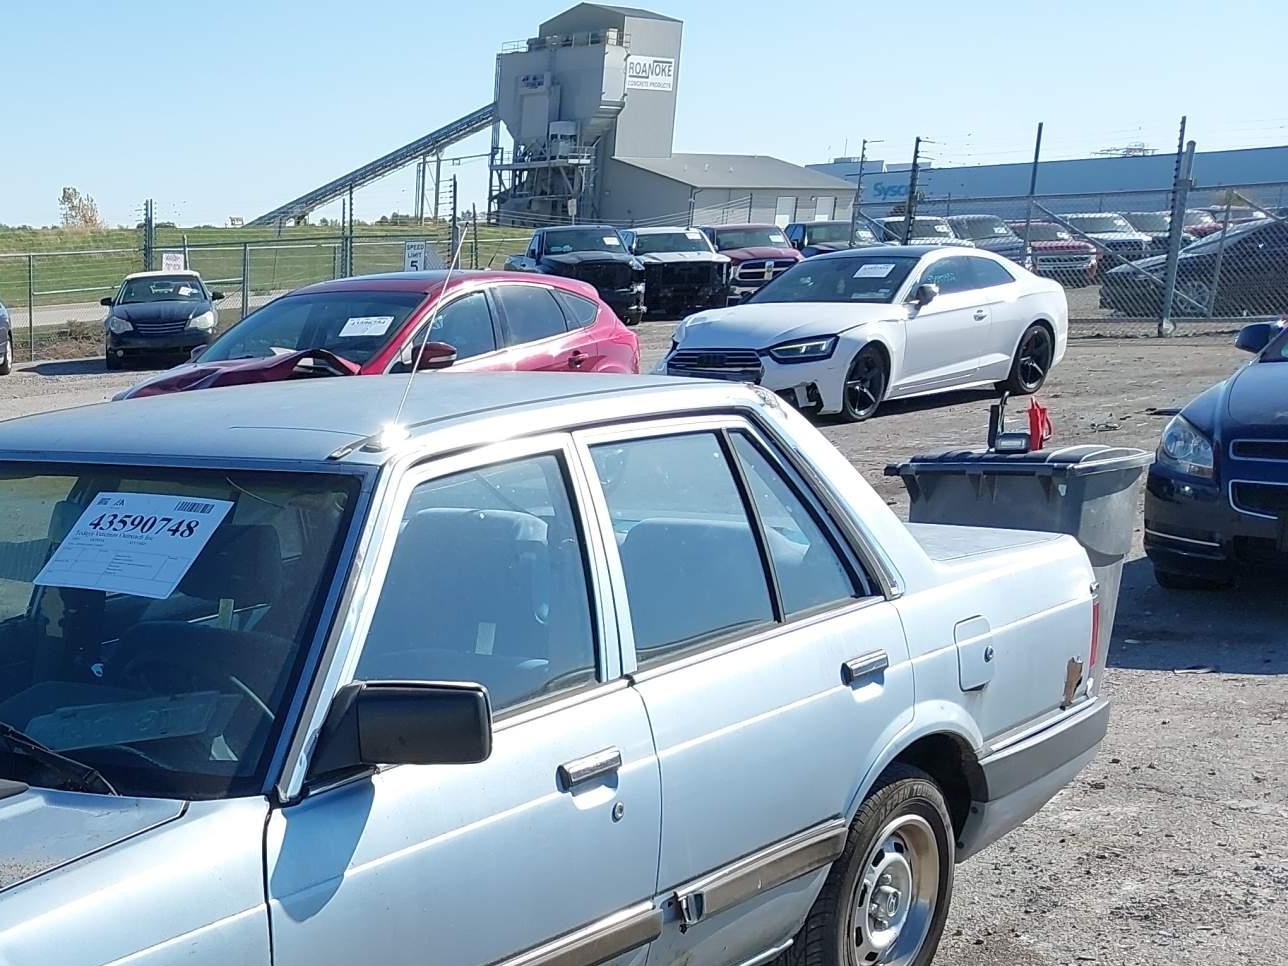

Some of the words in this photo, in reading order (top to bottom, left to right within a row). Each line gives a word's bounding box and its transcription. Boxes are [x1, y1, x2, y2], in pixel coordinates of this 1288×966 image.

[628, 61, 673, 78] ROANOKE
[410, 260, 418, 271] 5
[89, 513, 200, 538] 43590748
